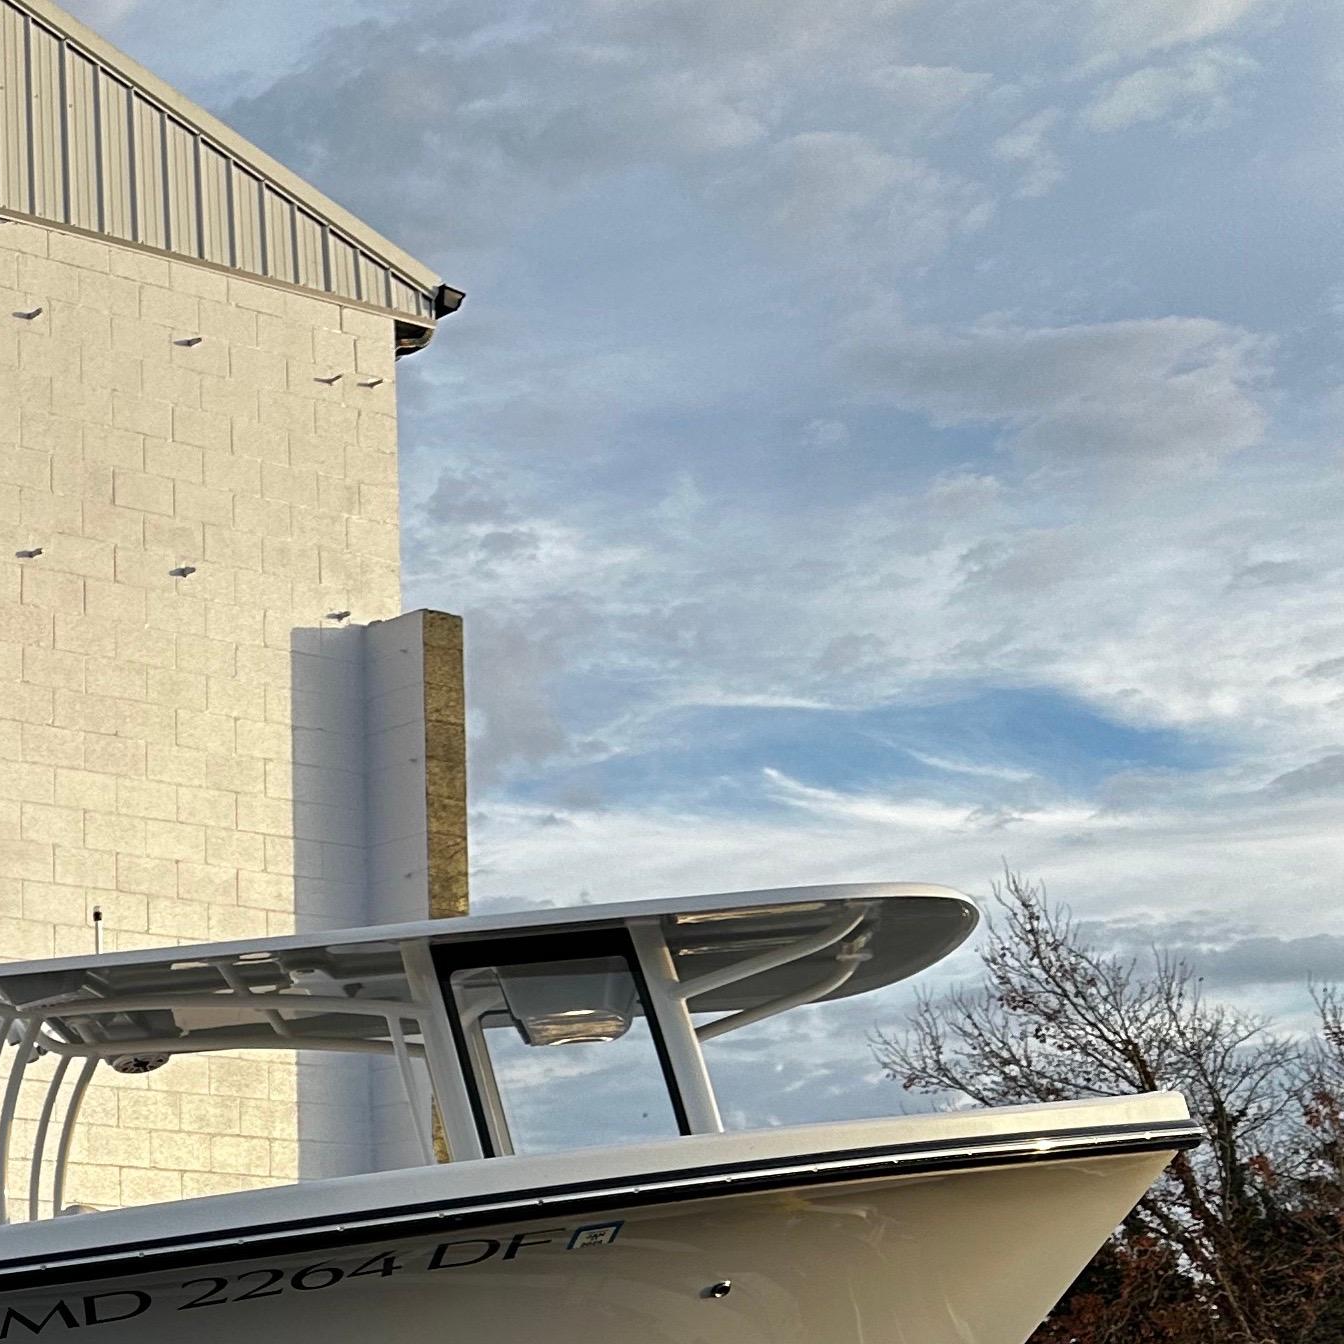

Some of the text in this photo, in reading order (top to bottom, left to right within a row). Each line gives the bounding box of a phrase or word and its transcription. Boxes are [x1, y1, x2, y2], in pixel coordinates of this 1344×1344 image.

[0, 1227, 566, 1339] MD 2264 DF
